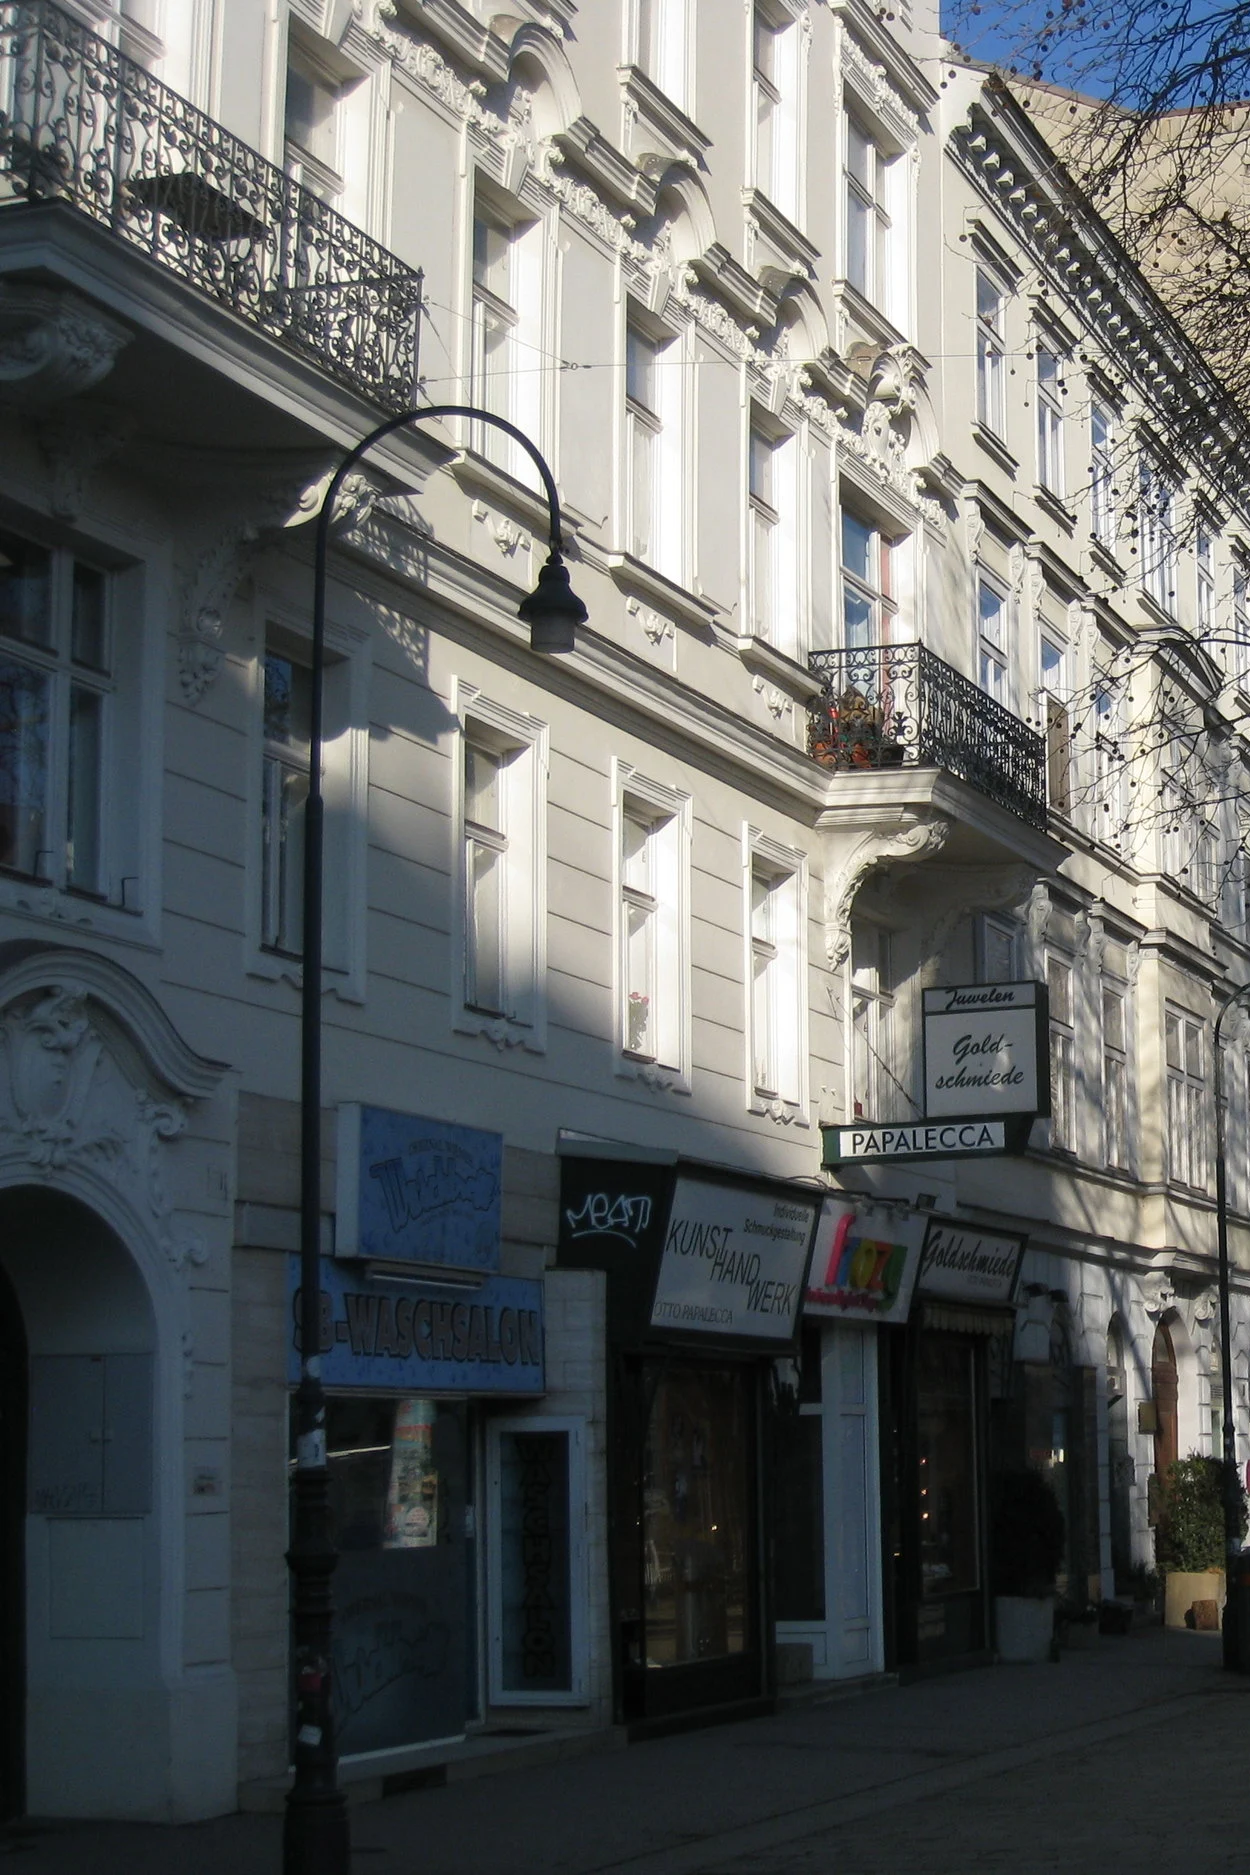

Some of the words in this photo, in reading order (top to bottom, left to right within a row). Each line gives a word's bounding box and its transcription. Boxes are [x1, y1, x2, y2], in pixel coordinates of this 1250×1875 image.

[945, 988, 1015, 1010] Juwelen
[953, 1033, 1013, 1065] Gold-
[935, 1065, 1024, 1089] schmiede
[852, 1124, 994, 1154] PAPALECCA
[773, 1203, 811, 1223] Individuelle
[666, 1218, 733, 1260] KUNST
[743, 1218, 806, 1246] Schmuckgestaltung
[709, 1247, 761, 1286] HAND
[921, 1229, 1015, 1279] Goldschmiede
[746, 1279, 798, 1316] WERK
[654, 1302, 681, 1318] OTTO
[683, 1304, 733, 1326] PAPALECCA
